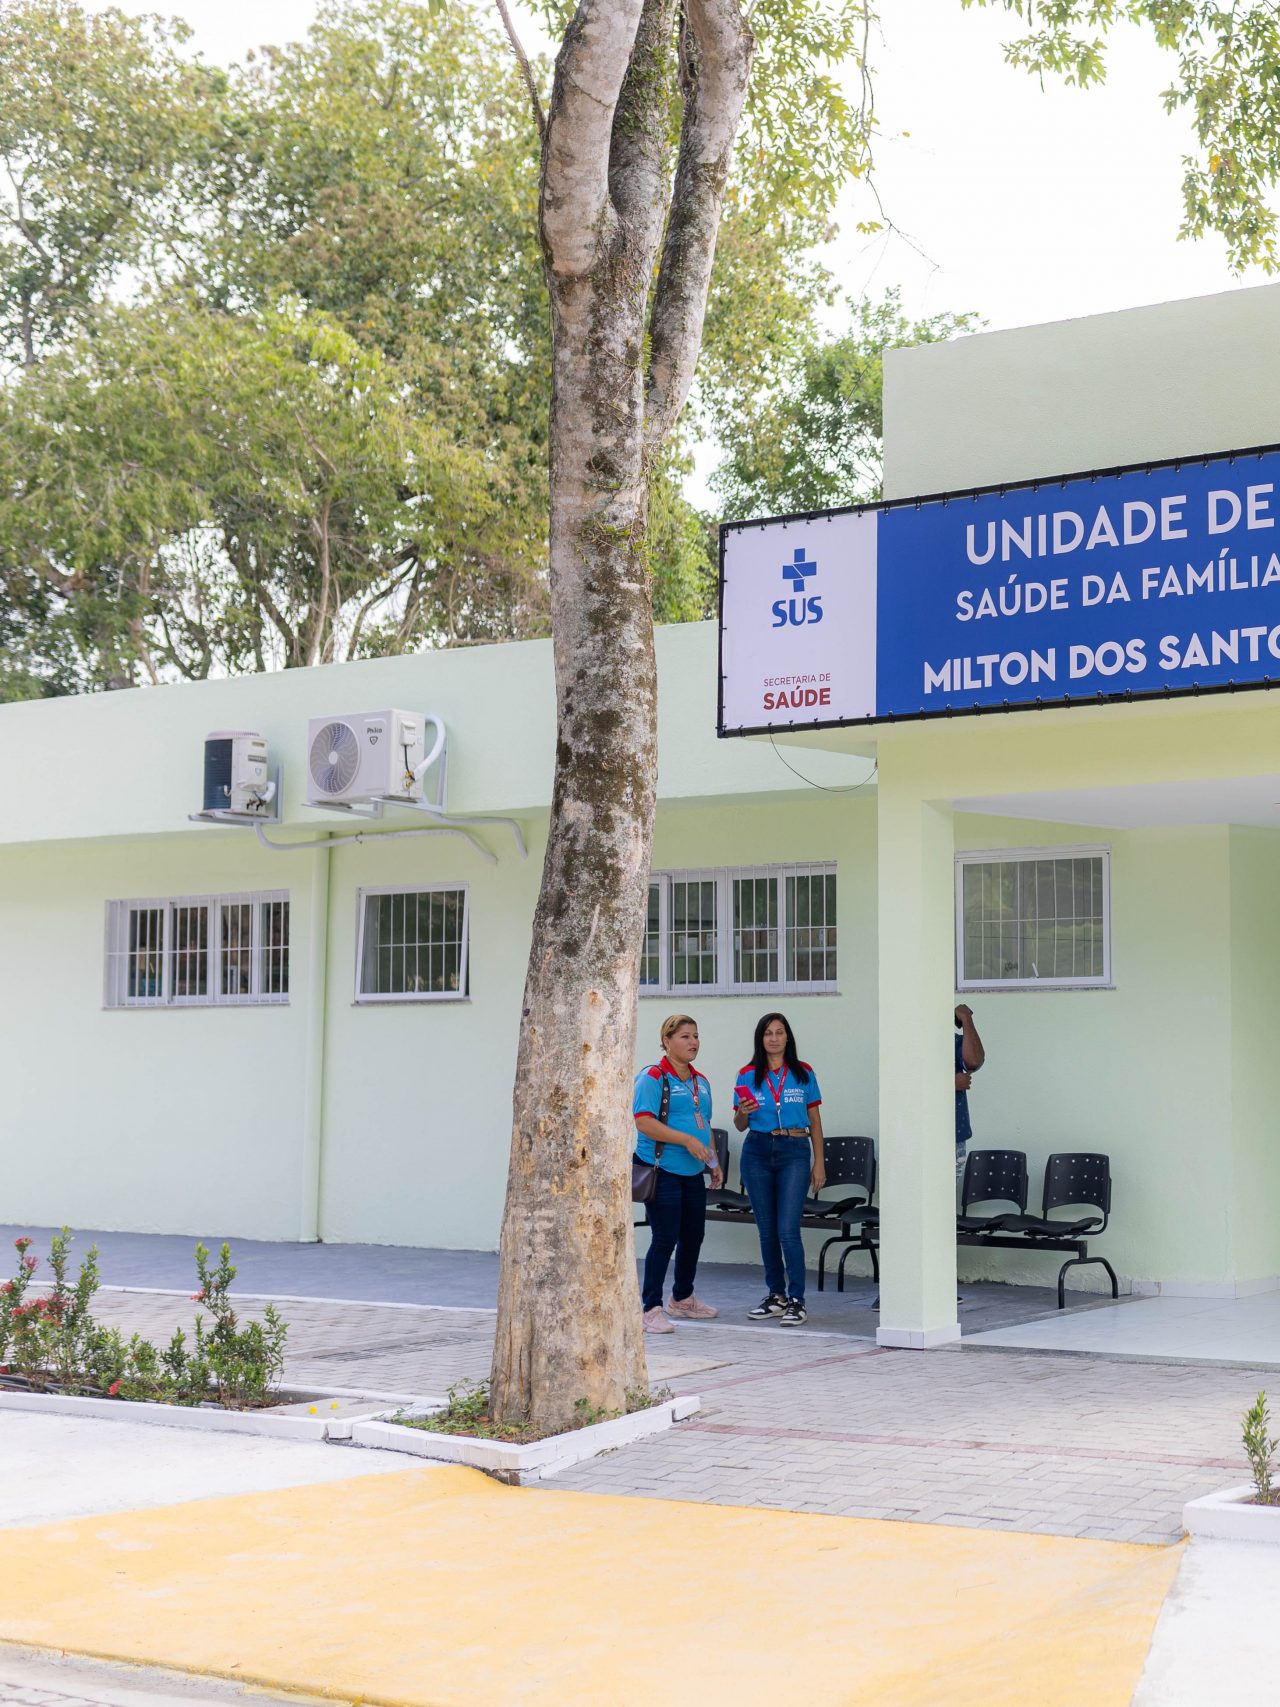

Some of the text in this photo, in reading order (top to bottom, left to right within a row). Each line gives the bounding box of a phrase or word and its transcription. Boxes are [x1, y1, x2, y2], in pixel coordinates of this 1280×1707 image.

[966, 483, 1275, 565] UNIDADE DE
[772, 596, 823, 627] SUS
[955, 574, 1069, 621] SAÚDE
[1082, 571, 1130, 606] DA
[764, 673, 831, 686] SECRETARIA DE
[923, 648, 1056, 694] MILTON
[1069, 638, 1147, 679] DOS
[763, 685, 831, 711] SAÚDE
